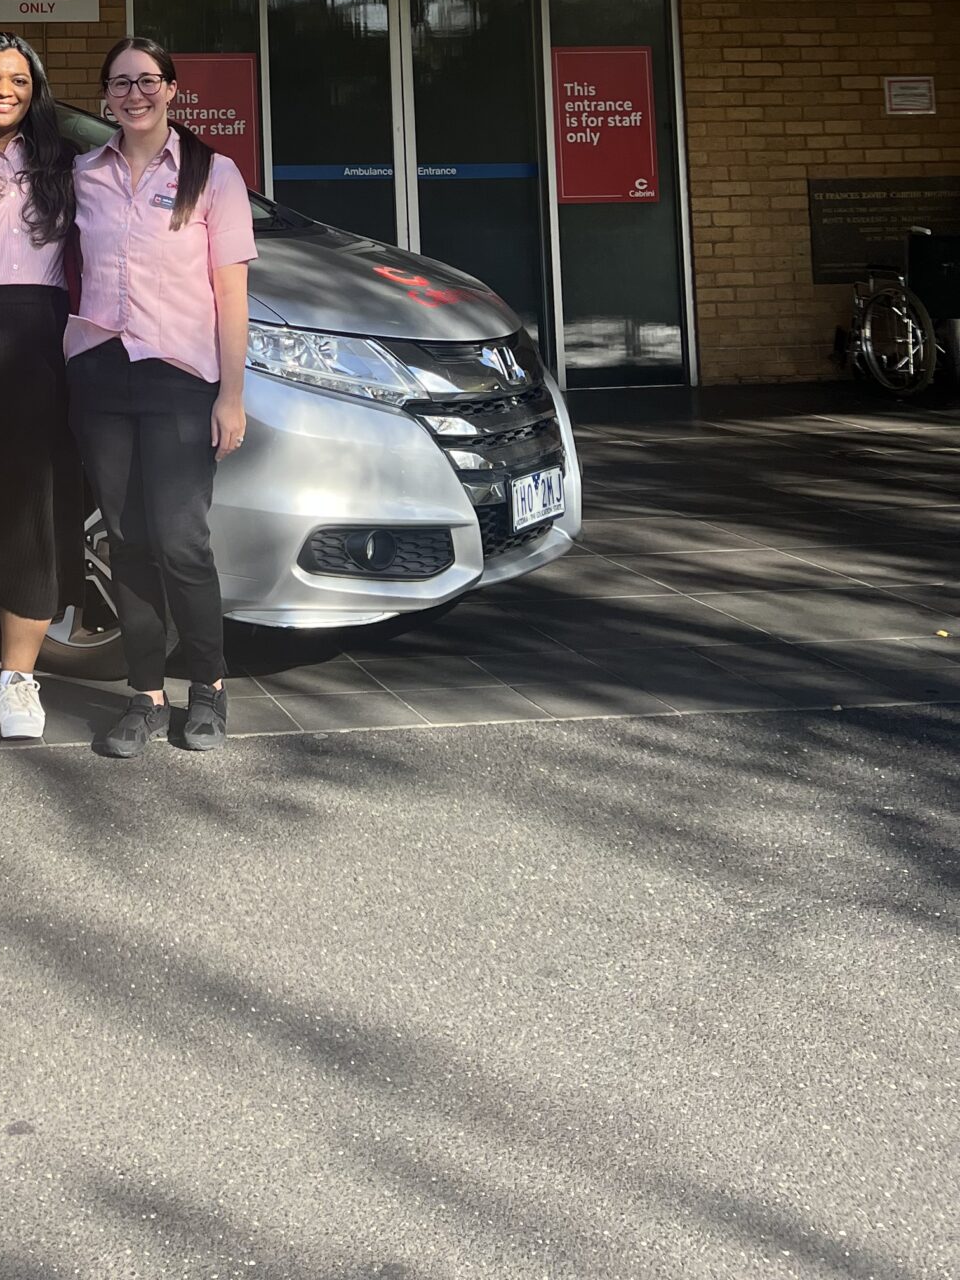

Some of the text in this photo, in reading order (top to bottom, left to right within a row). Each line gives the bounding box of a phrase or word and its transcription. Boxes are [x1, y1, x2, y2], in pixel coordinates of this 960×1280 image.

[19, 2, 56, 14] ONLY
[563, 81, 596, 97] This
[176, 89, 199, 104] his
[565, 100, 633, 112] entrance
[167, 107, 237, 119] entrance
[565, 111, 642, 127] is for staff
[210, 119, 246, 135] staff
[566, 128, 601, 146] only
[343, 167, 457, 176] Ambulance Entrance
[628, 189, 656, 198] Cabrini
